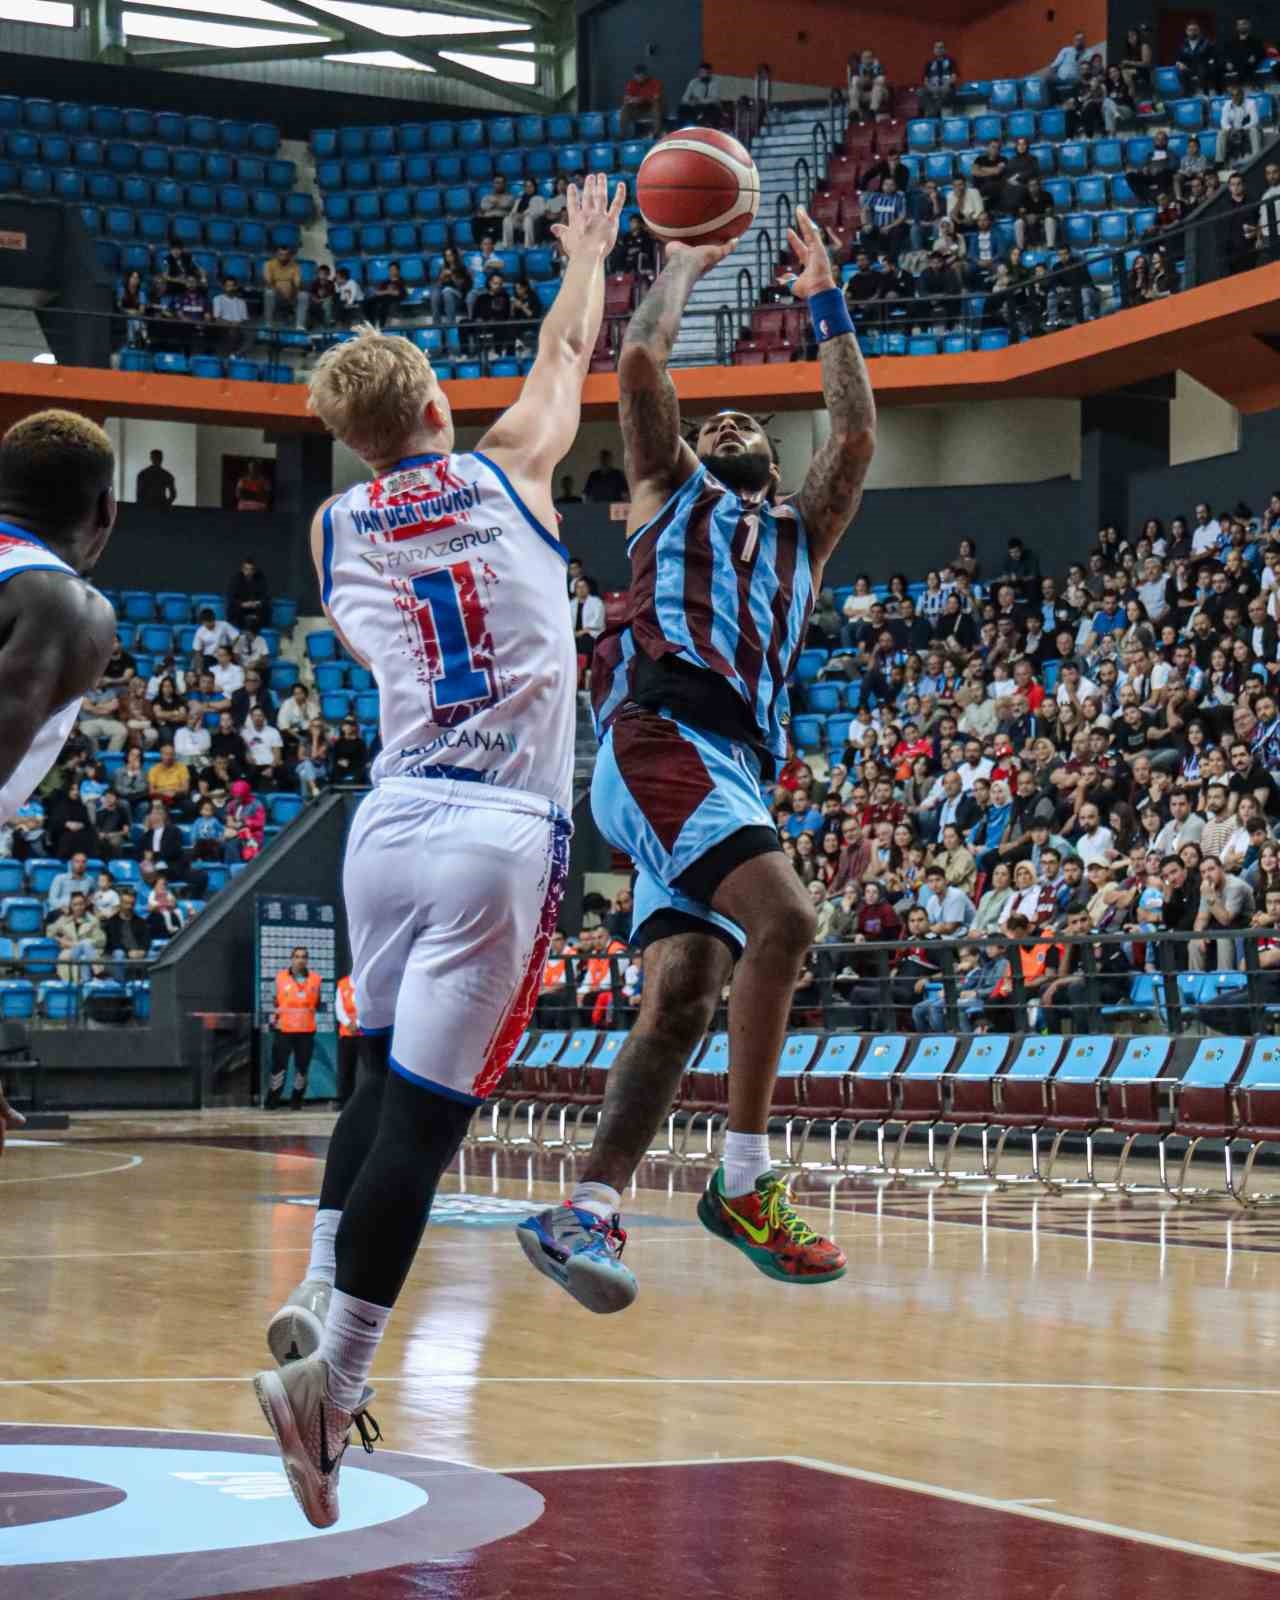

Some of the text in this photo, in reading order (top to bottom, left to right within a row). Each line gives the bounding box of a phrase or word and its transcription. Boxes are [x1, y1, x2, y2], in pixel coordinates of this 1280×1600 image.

[350, 509, 384, 535] VAN
[740, 514, 759, 562] 1
[386, 526, 503, 569] FARAZGRUP
[409, 564, 493, 711] 1
